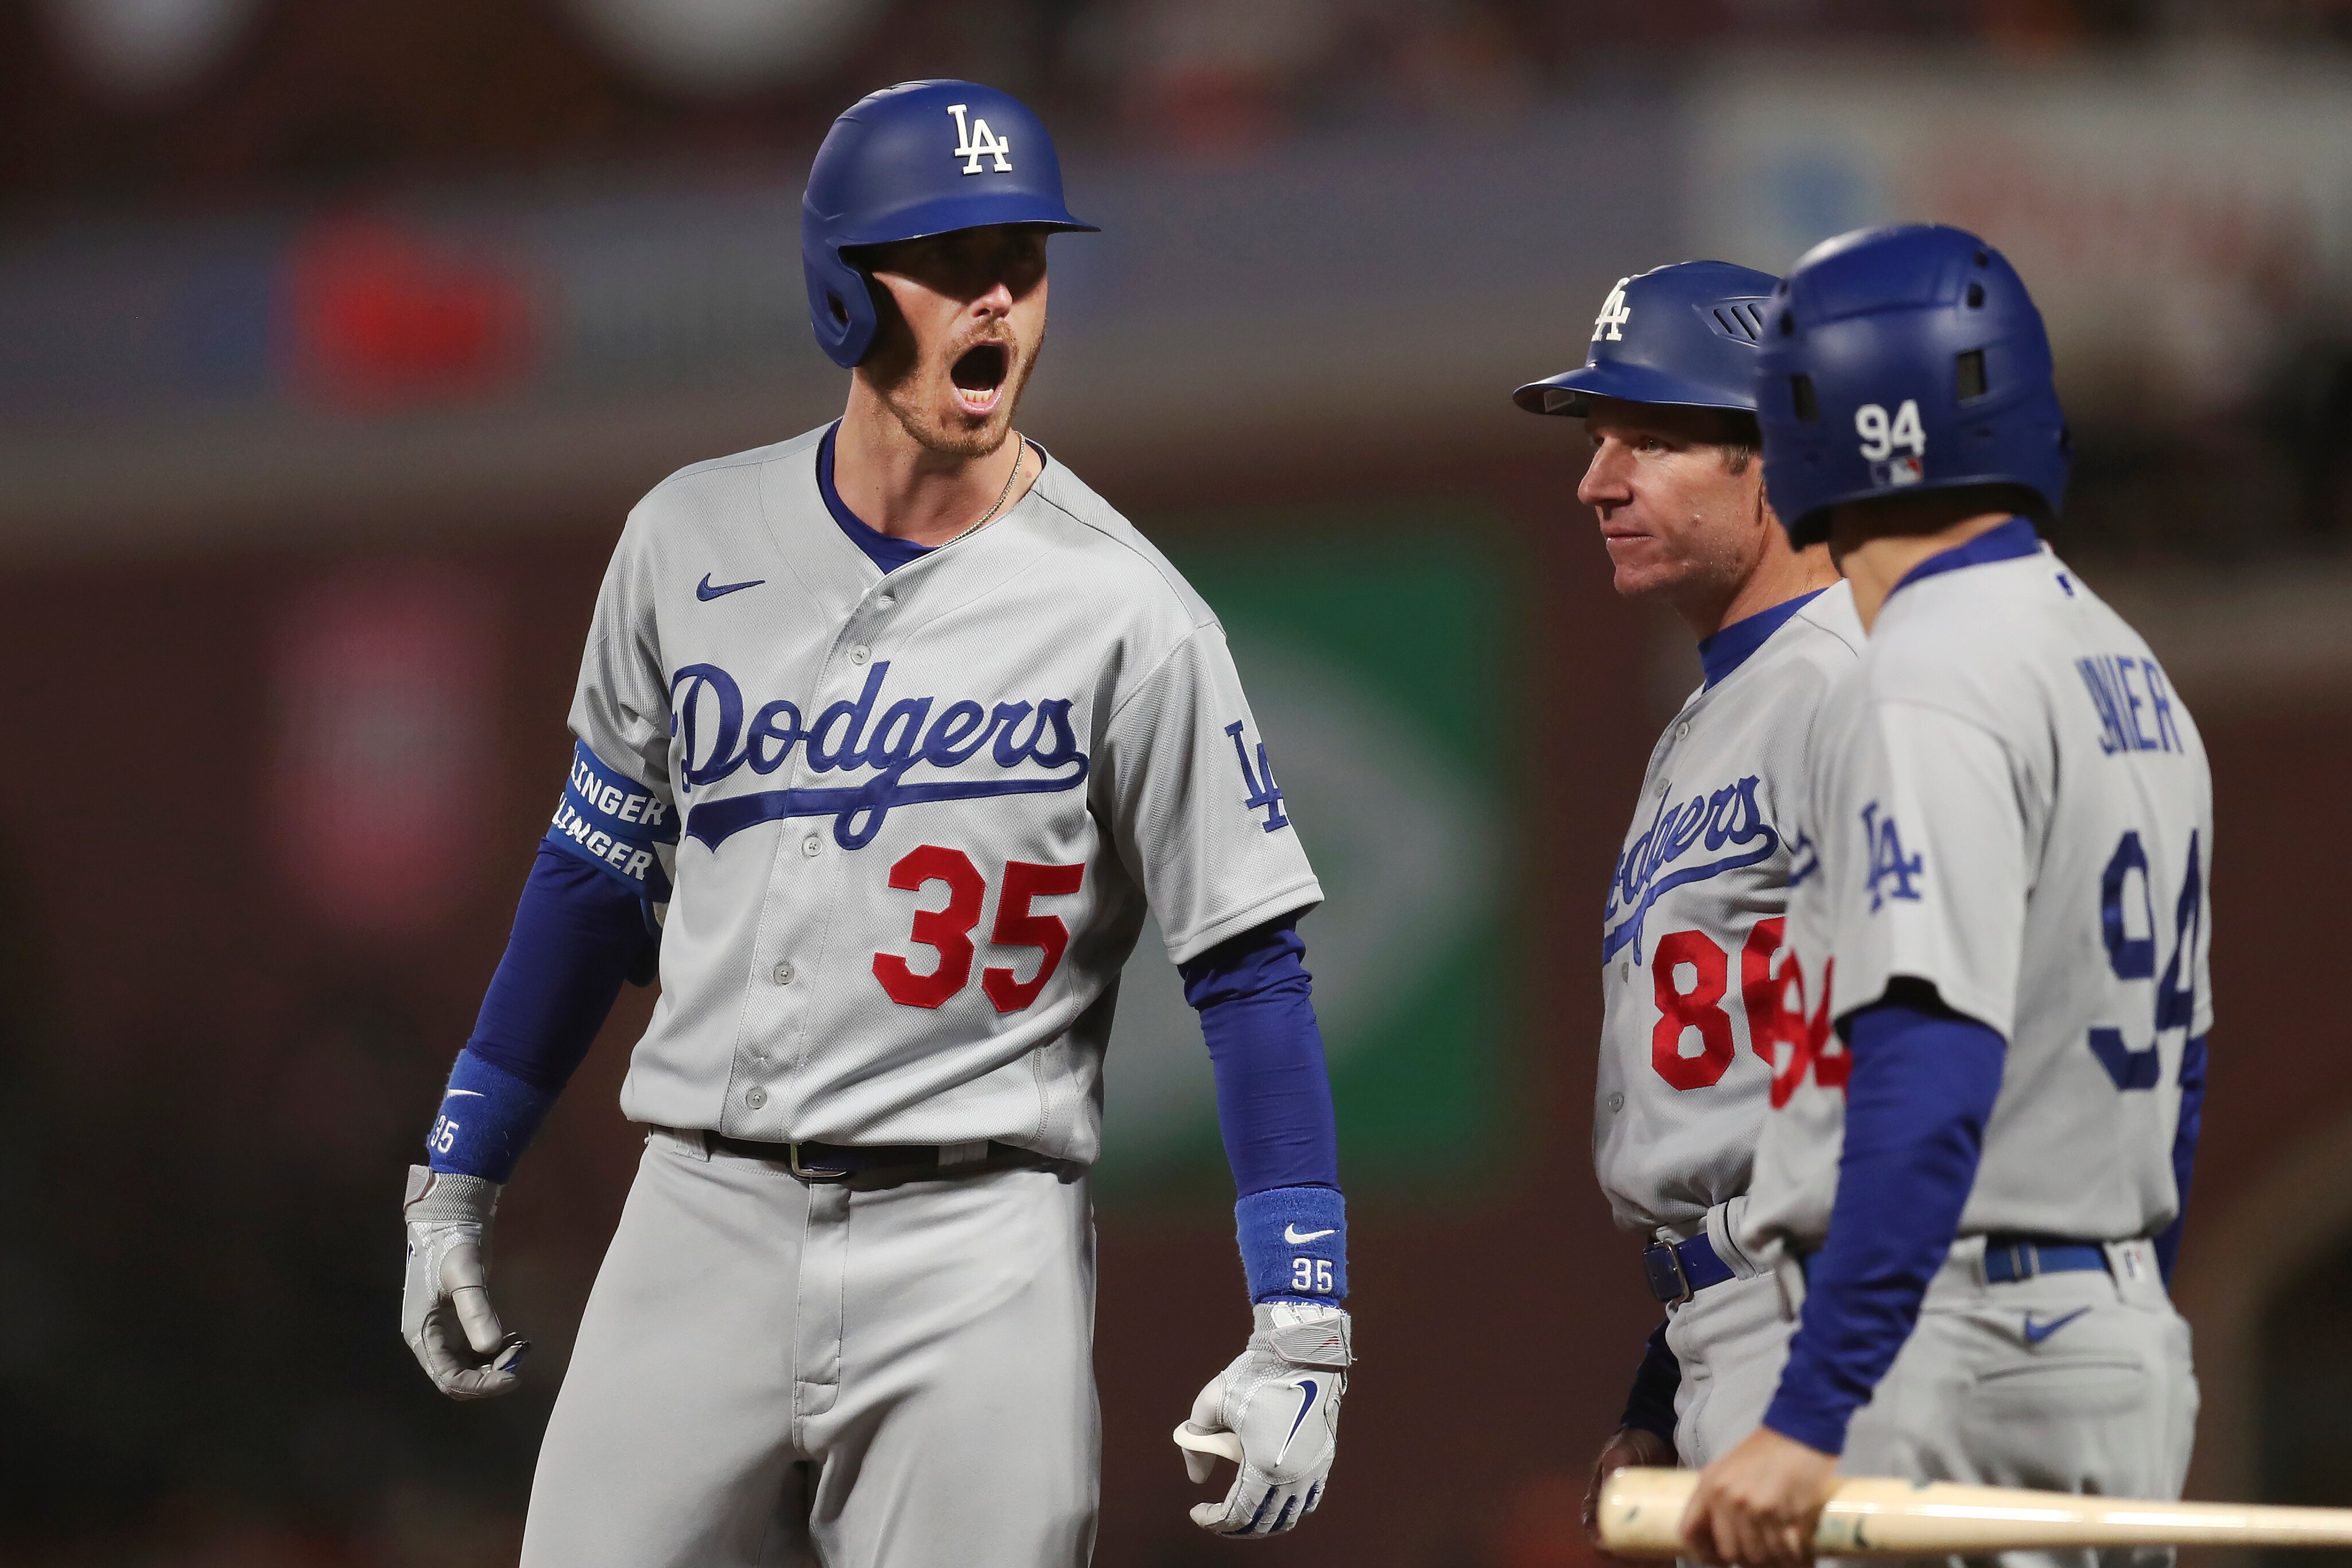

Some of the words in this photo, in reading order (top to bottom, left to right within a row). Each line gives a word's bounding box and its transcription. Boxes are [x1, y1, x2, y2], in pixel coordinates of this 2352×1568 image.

[947, 104, 1012, 174] LA
[1855, 399, 1927, 461] 94
[570, 740, 666, 825] LINGER
[670, 661, 1089, 850] Dodgers
[552, 792, 653, 880] LINGER
[1861, 801, 1923, 912] LA
[872, 844, 1085, 1012] 35
[2089, 829, 2202, 1090] 94
[1291, 1257, 1333, 1294] 35
